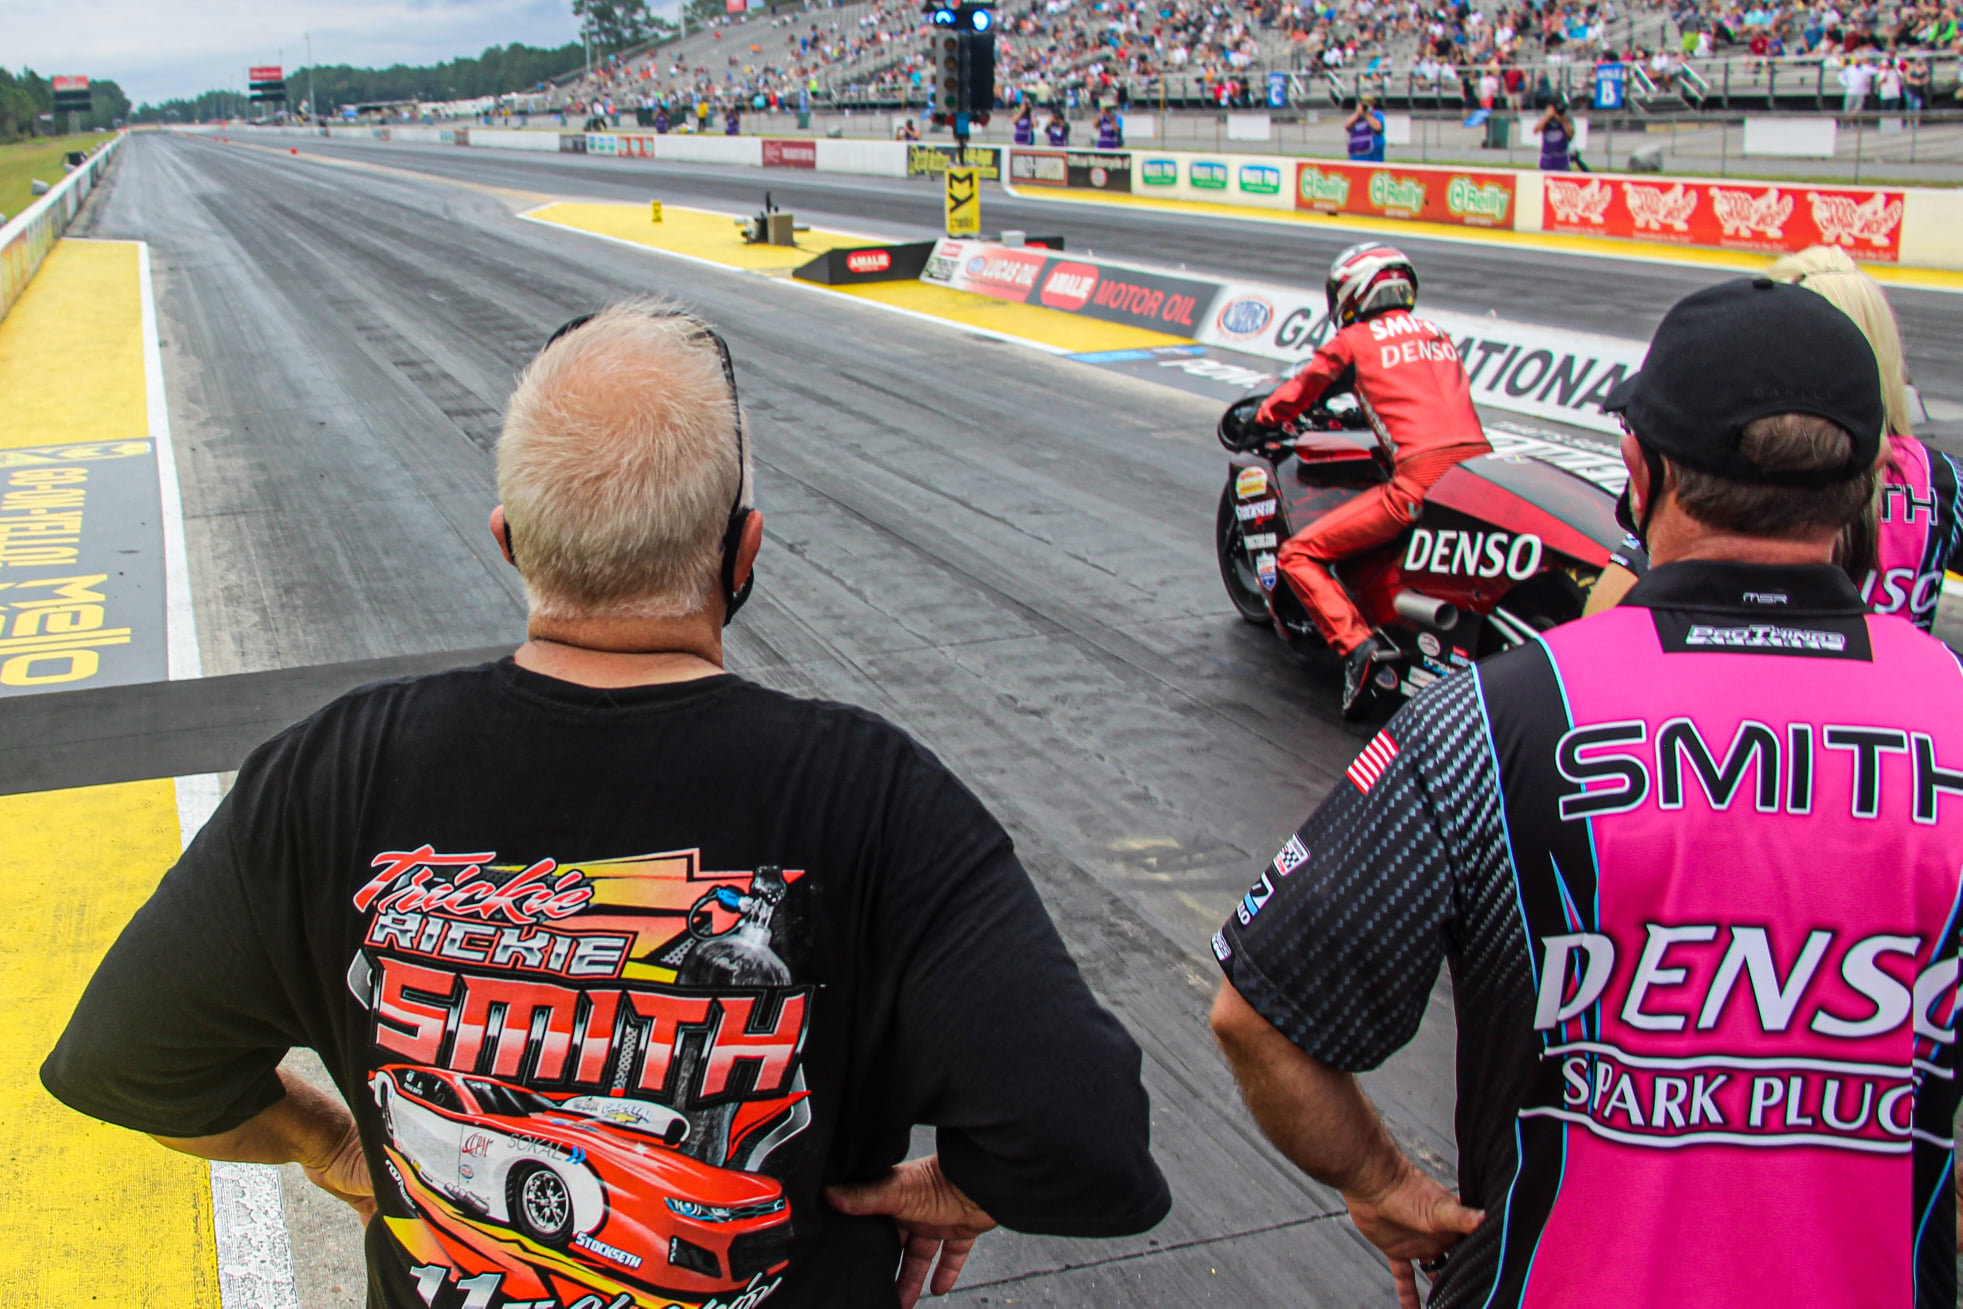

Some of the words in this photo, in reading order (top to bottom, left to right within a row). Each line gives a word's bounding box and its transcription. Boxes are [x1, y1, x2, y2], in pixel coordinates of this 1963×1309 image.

[1602, 81, 1616, 105] B
[850, 254, 888, 268] AMALIE
[982, 259, 1021, 282] LUCAS
[1015, 264, 1038, 286] OIL
[1045, 272, 1095, 299] AMALIE
[1093, 279, 1165, 318] MOTOR
[1162, 294, 1196, 326] OIL
[1274, 308, 1329, 351] GA
[1381, 338, 1458, 369] DENSO
[1880, 484, 1938, 526] TH
[1404, 528, 1542, 581] DENSO
[352, 844, 596, 922] Trickie
[369, 908, 636, 980] RICKIE
[376, 957, 808, 1098] SMITH
[1561, 1056, 1730, 1128] SPARK
[1749, 1073, 1923, 1137] PLUG
[507, 1133, 562, 1161] SOKAL
[575, 1232, 643, 1268] STOCKSETH
